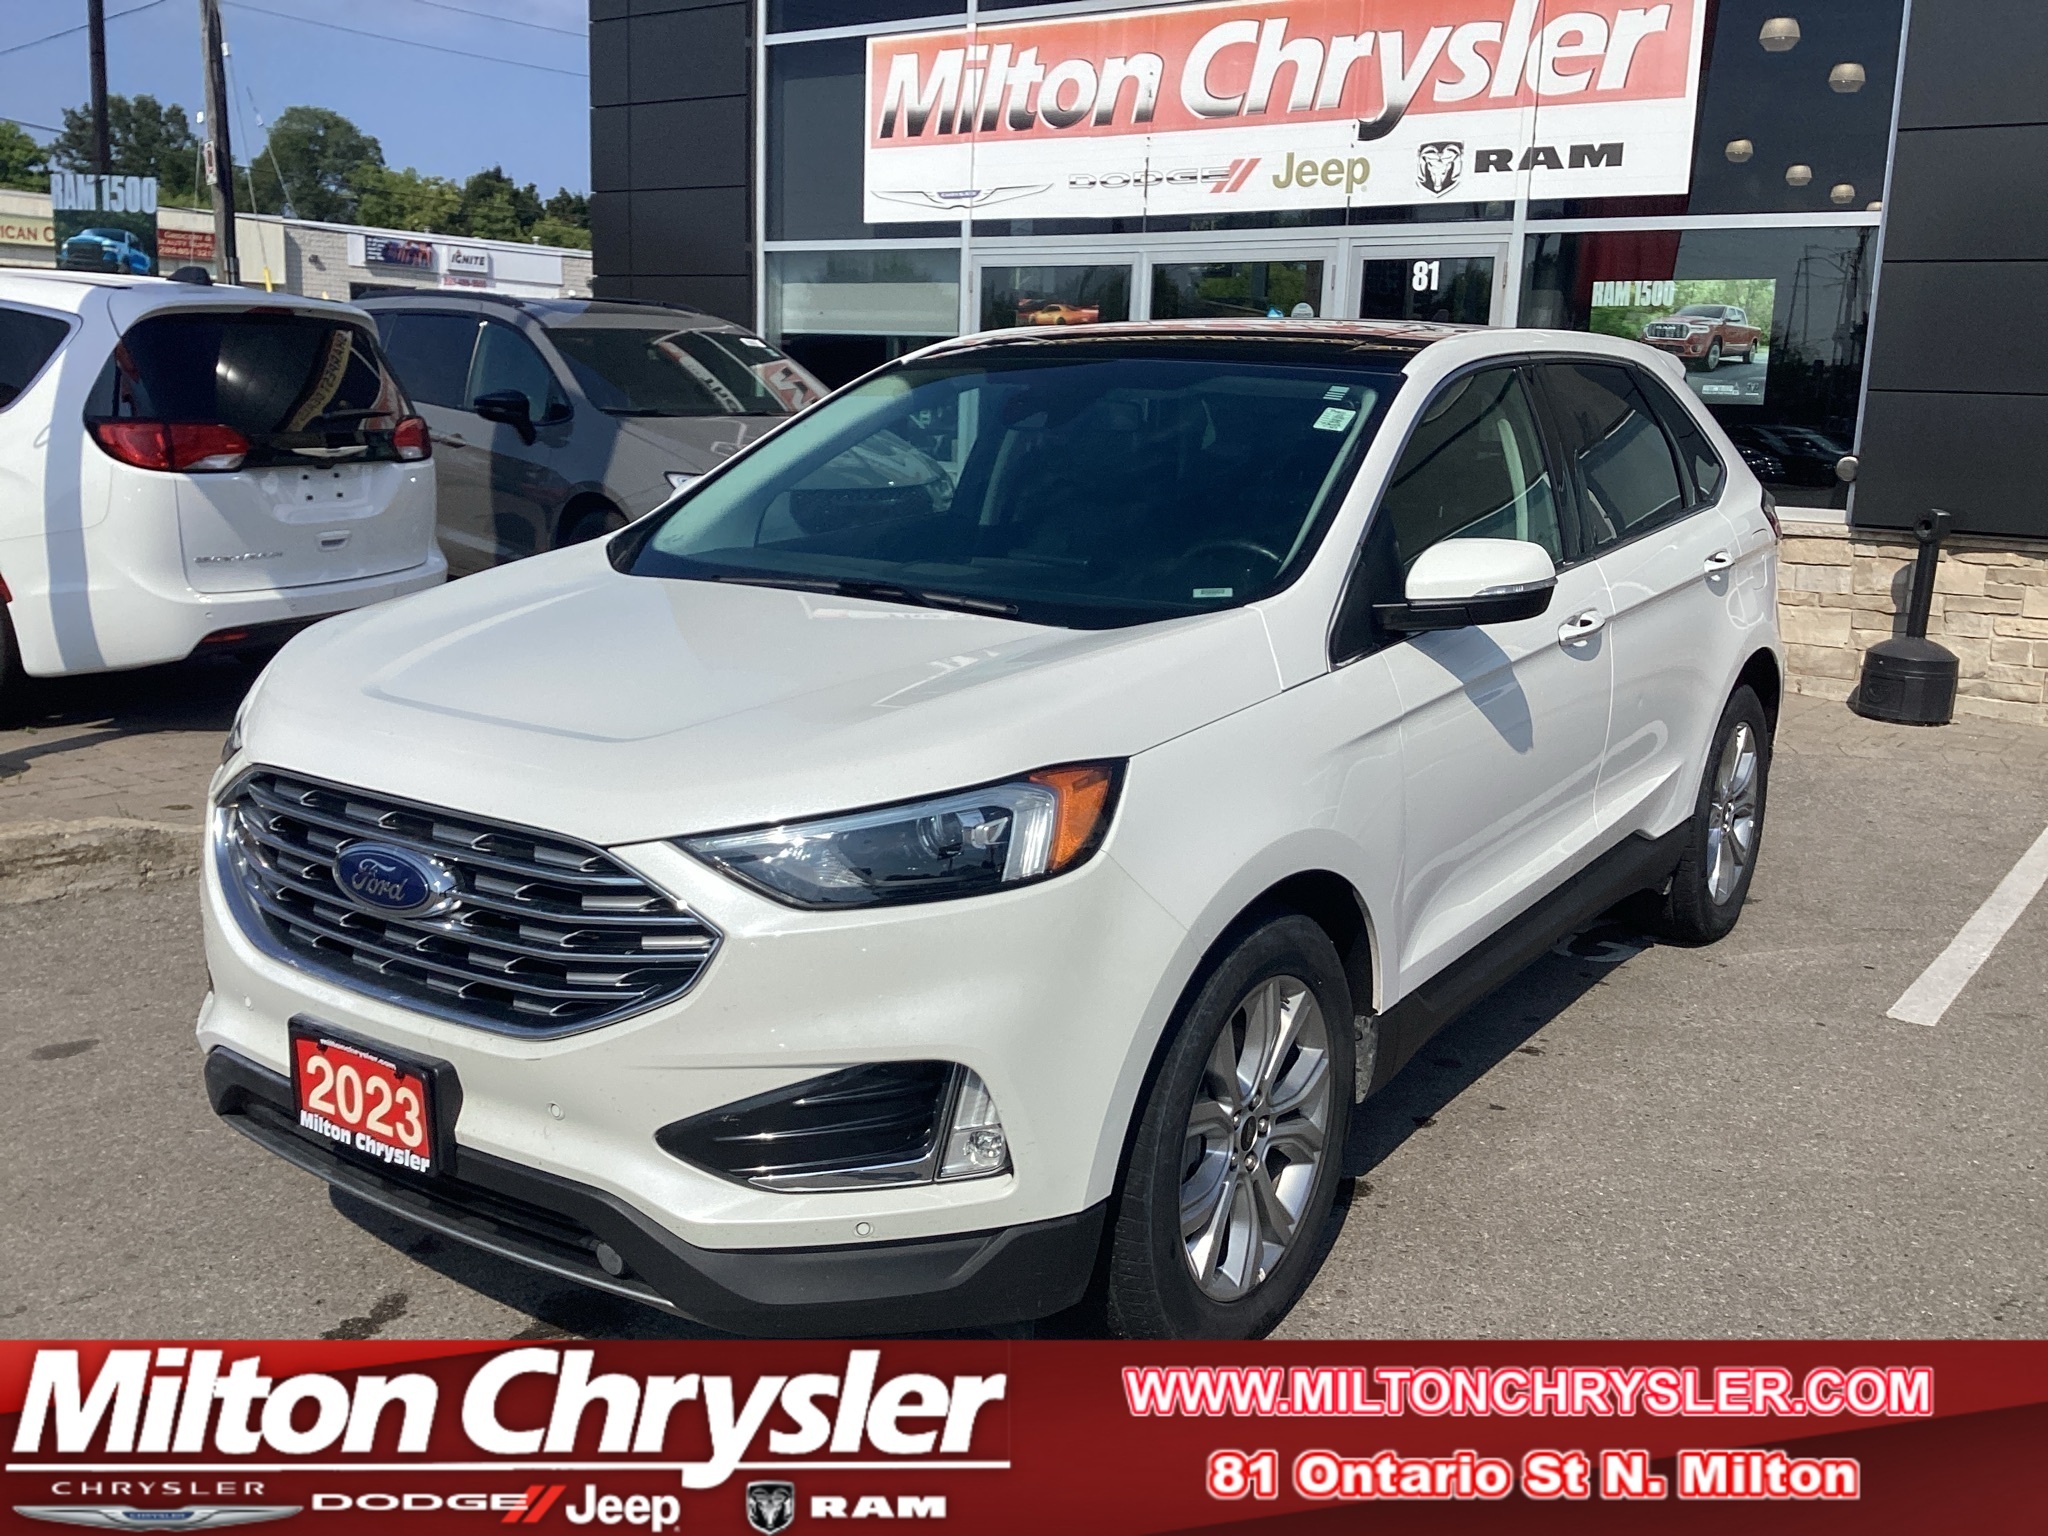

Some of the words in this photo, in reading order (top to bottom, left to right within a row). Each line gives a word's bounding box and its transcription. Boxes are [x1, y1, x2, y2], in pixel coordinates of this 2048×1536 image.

[880, 48, 1163, 140] Milton
[1180, 0, 1669, 141] Chrysler
[1272, 152, 1370, 194] Jeep
[1474, 142, 1624, 173] RAM
[51, 174, 96, 210] RAM
[100, 175, 157, 213] 1500
[1068, 167, 1231, 190] DODGE
[452, 253, 485, 265] IGNITE
[1412, 260, 1439, 292] 81
[1592, 281, 1631, 307] RAM
[1634, 281, 1675, 307] 1500
[351, 858, 408, 901] Ford
[306, 1055, 423, 1148] 2023
[300, 1109, 351, 1145] Milton
[355, 1132, 430, 1173] Chrysler
